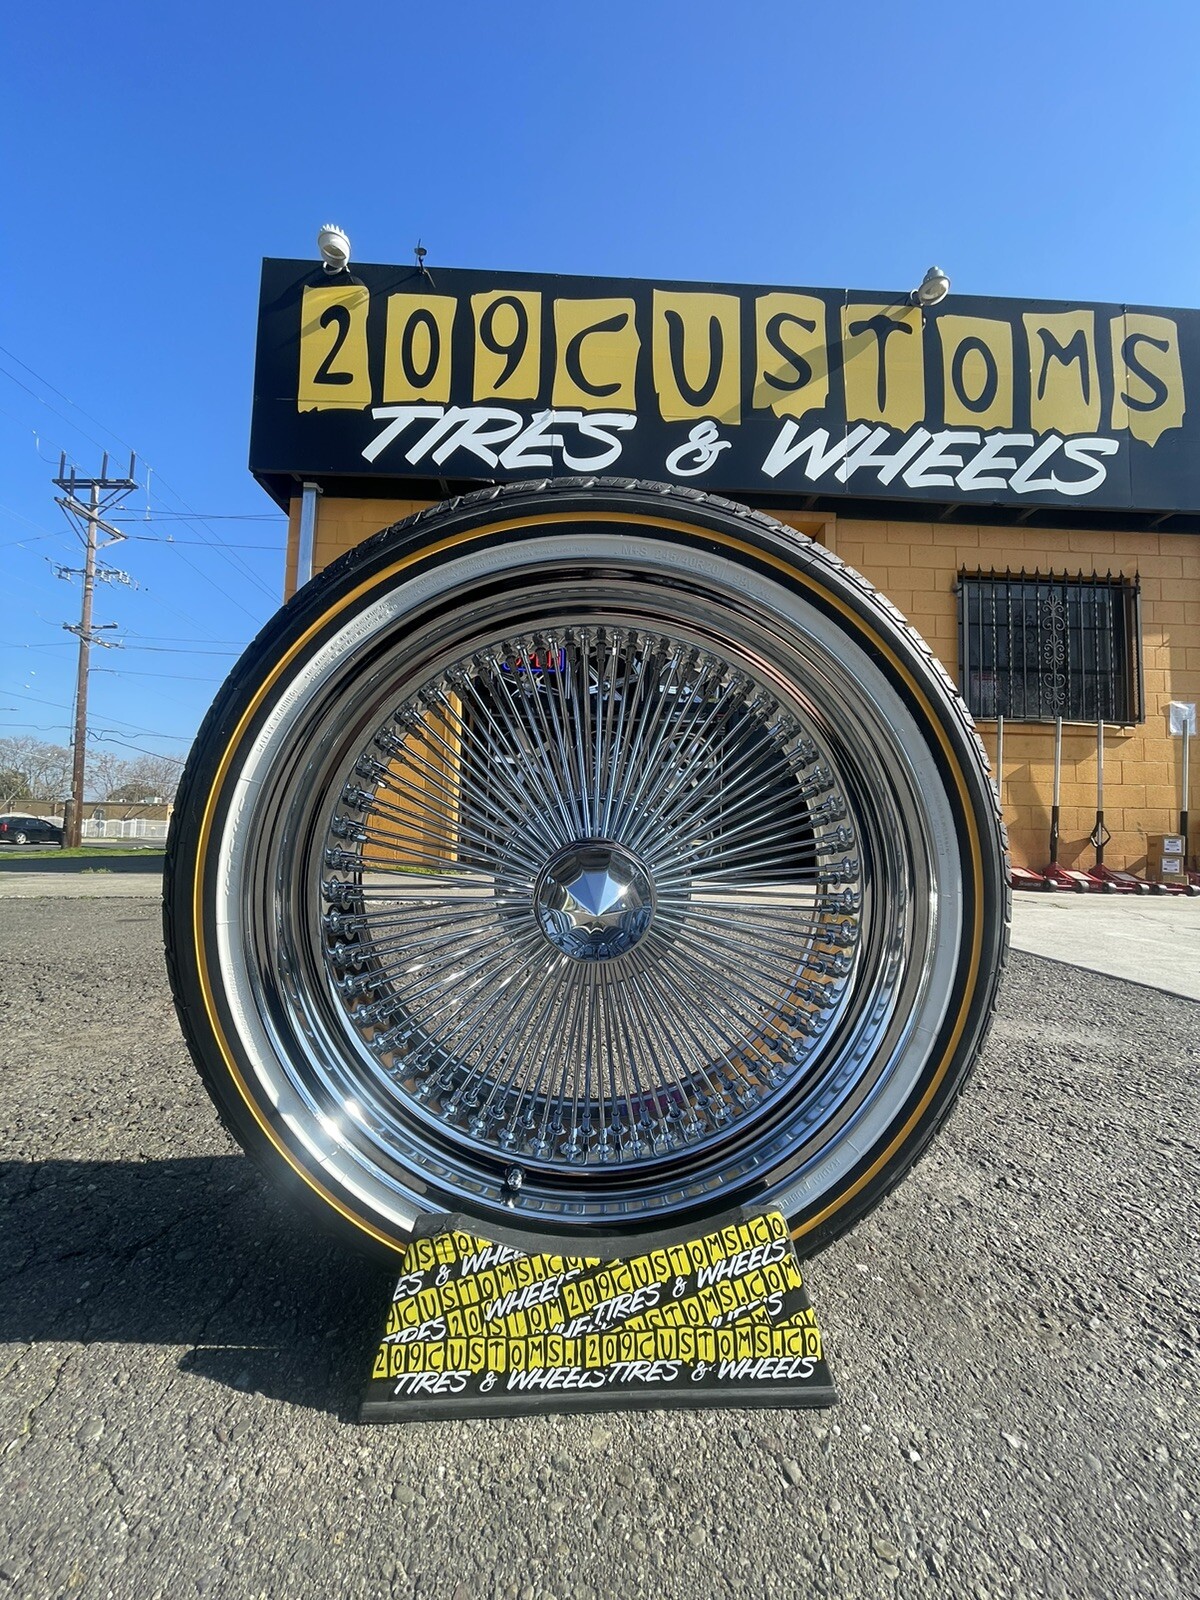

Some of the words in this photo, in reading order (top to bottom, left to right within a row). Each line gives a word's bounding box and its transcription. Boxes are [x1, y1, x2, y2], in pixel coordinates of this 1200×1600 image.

[361, 405, 637, 472] TIRES
[666, 420, 731, 477] &
[761, 420, 1119, 496] WHEELS
[404, 1235, 479, 1273] USTO
[435, 1264, 451, 1286] &
[593, 1283, 661, 1324] TIRES
[672, 1276, 688, 1297] &
[697, 1238, 786, 1288] WHEELS
[394, 1370, 471, 1395] TIRES
[480, 1371, 497, 1392] &
[507, 1367, 605, 1390] WHEELS
[609, 1360, 682, 1383] TIRES
[691, 1361, 708, 1382] &
[718, 1356, 817, 1379] WHEELS
